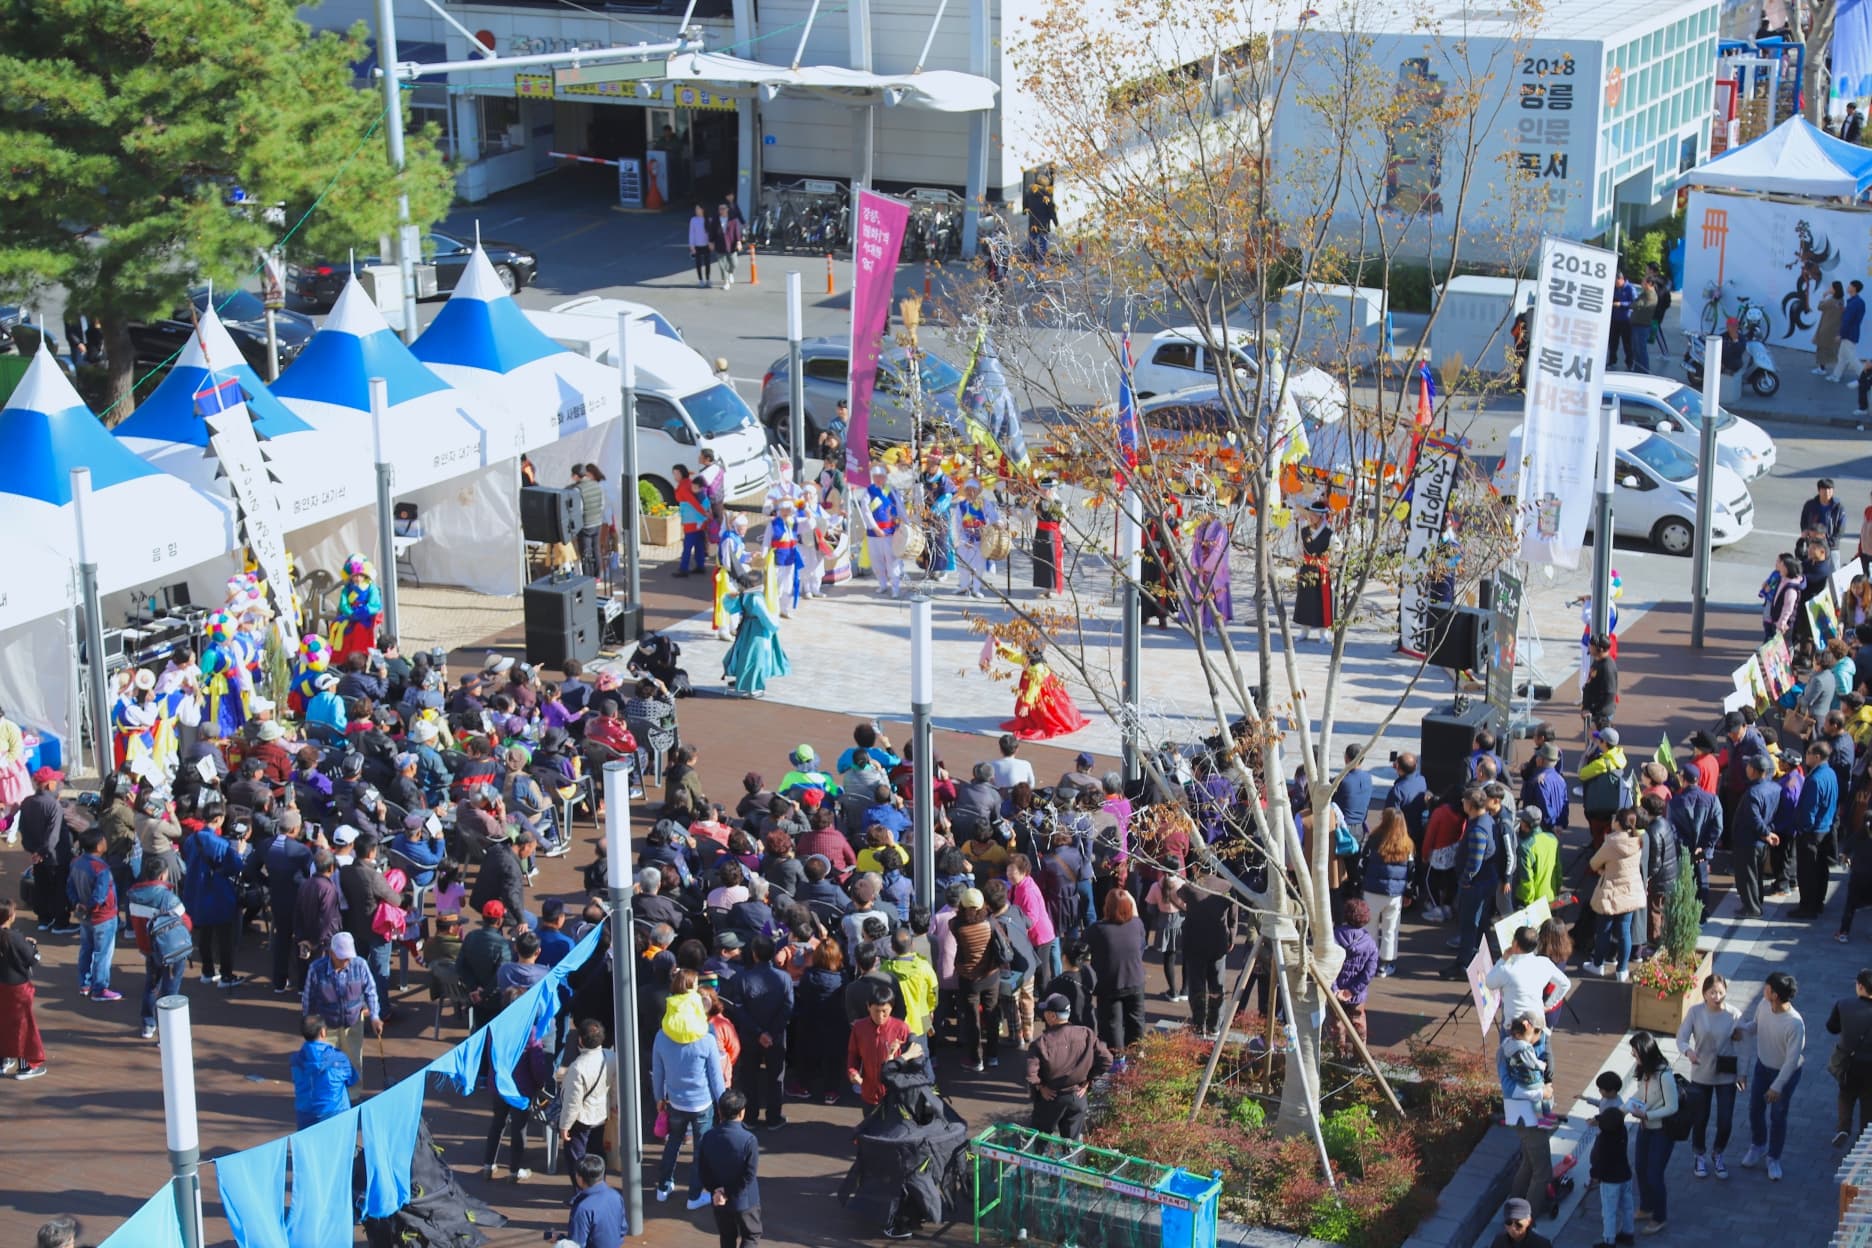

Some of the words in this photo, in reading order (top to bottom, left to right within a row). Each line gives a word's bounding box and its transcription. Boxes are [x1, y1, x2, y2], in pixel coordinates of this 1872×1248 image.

[1522, 57, 1575, 76] 2018
[1519, 82, 1574, 111] 강릉
[1517, 117, 1571, 145] 인문
[1516, 152, 1569, 180] 독서
[1551, 252, 1608, 280] 2018
[1547, 277, 1605, 314] 강릉
[1544, 312, 1600, 350] 인문
[1538, 346, 1594, 384] 독서
[1533, 382, 1590, 417] 대전
